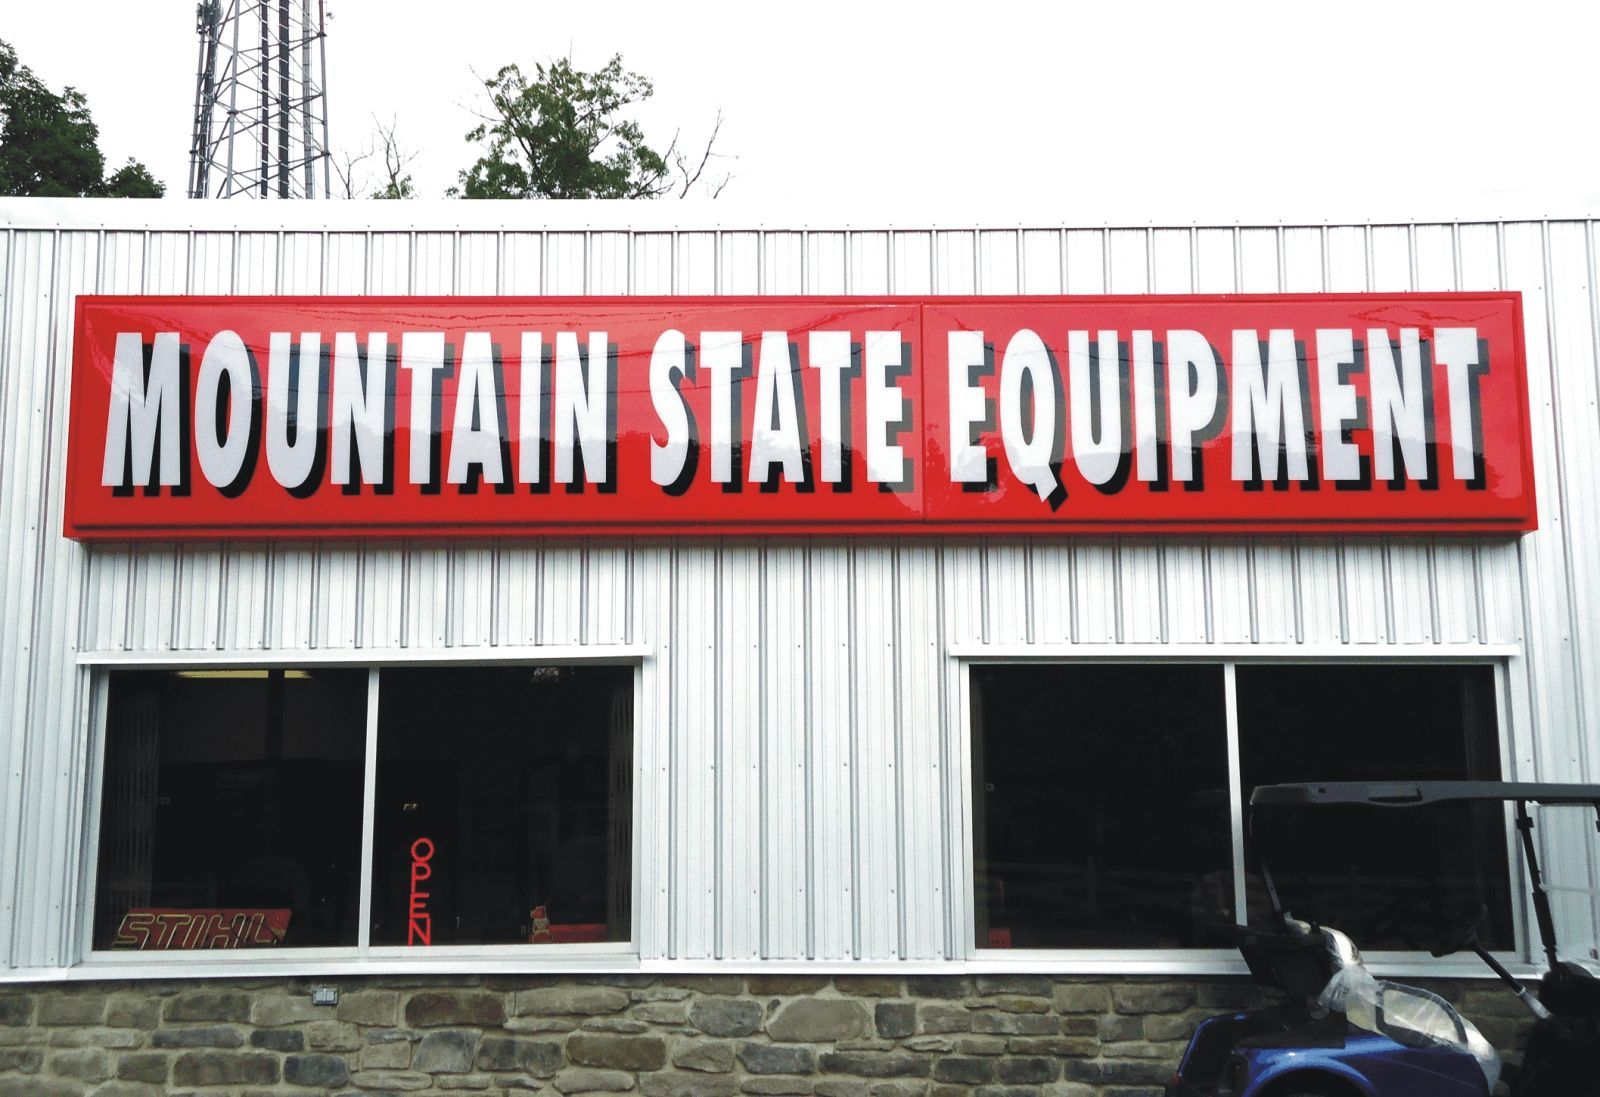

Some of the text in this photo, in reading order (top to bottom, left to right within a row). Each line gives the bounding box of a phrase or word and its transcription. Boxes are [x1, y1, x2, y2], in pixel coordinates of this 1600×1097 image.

[101, 327, 1483, 504] MOUNTAIN STATE EQUIPMENT
[112, 912, 274, 950] STIHL
[408, 837, 435, 946] OPEN
